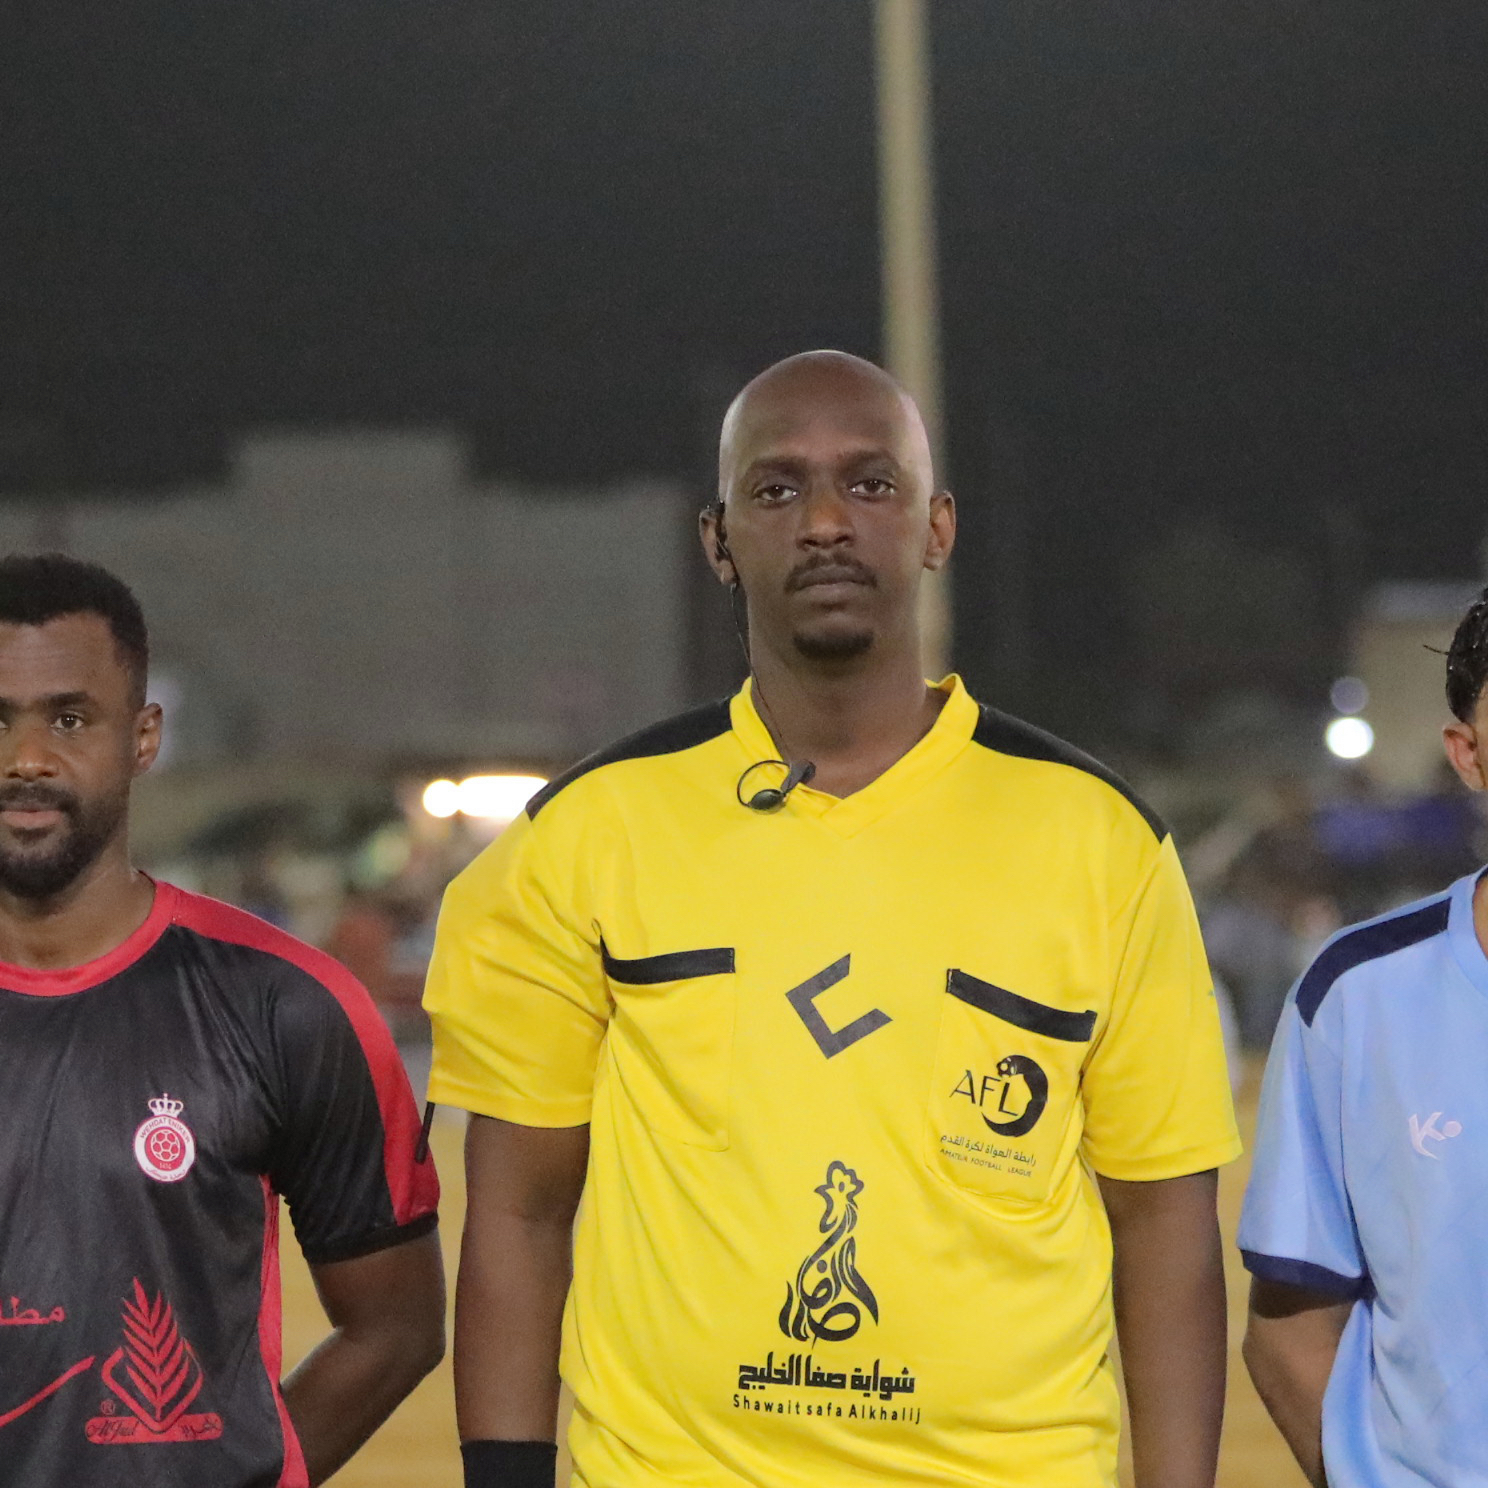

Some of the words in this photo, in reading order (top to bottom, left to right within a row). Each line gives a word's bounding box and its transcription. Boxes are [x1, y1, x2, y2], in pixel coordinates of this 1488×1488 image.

[948, 1069, 1019, 1117] AFL
[738, 1350, 803, 1391] الخليج
[804, 1354, 847, 1390] صفا
[850, 1358, 916, 1402] شواية
[732, 1393, 801, 1416] Shawait
[806, 1402, 842, 1418] safa
[848, 1404, 922, 1425] Alkhalij
